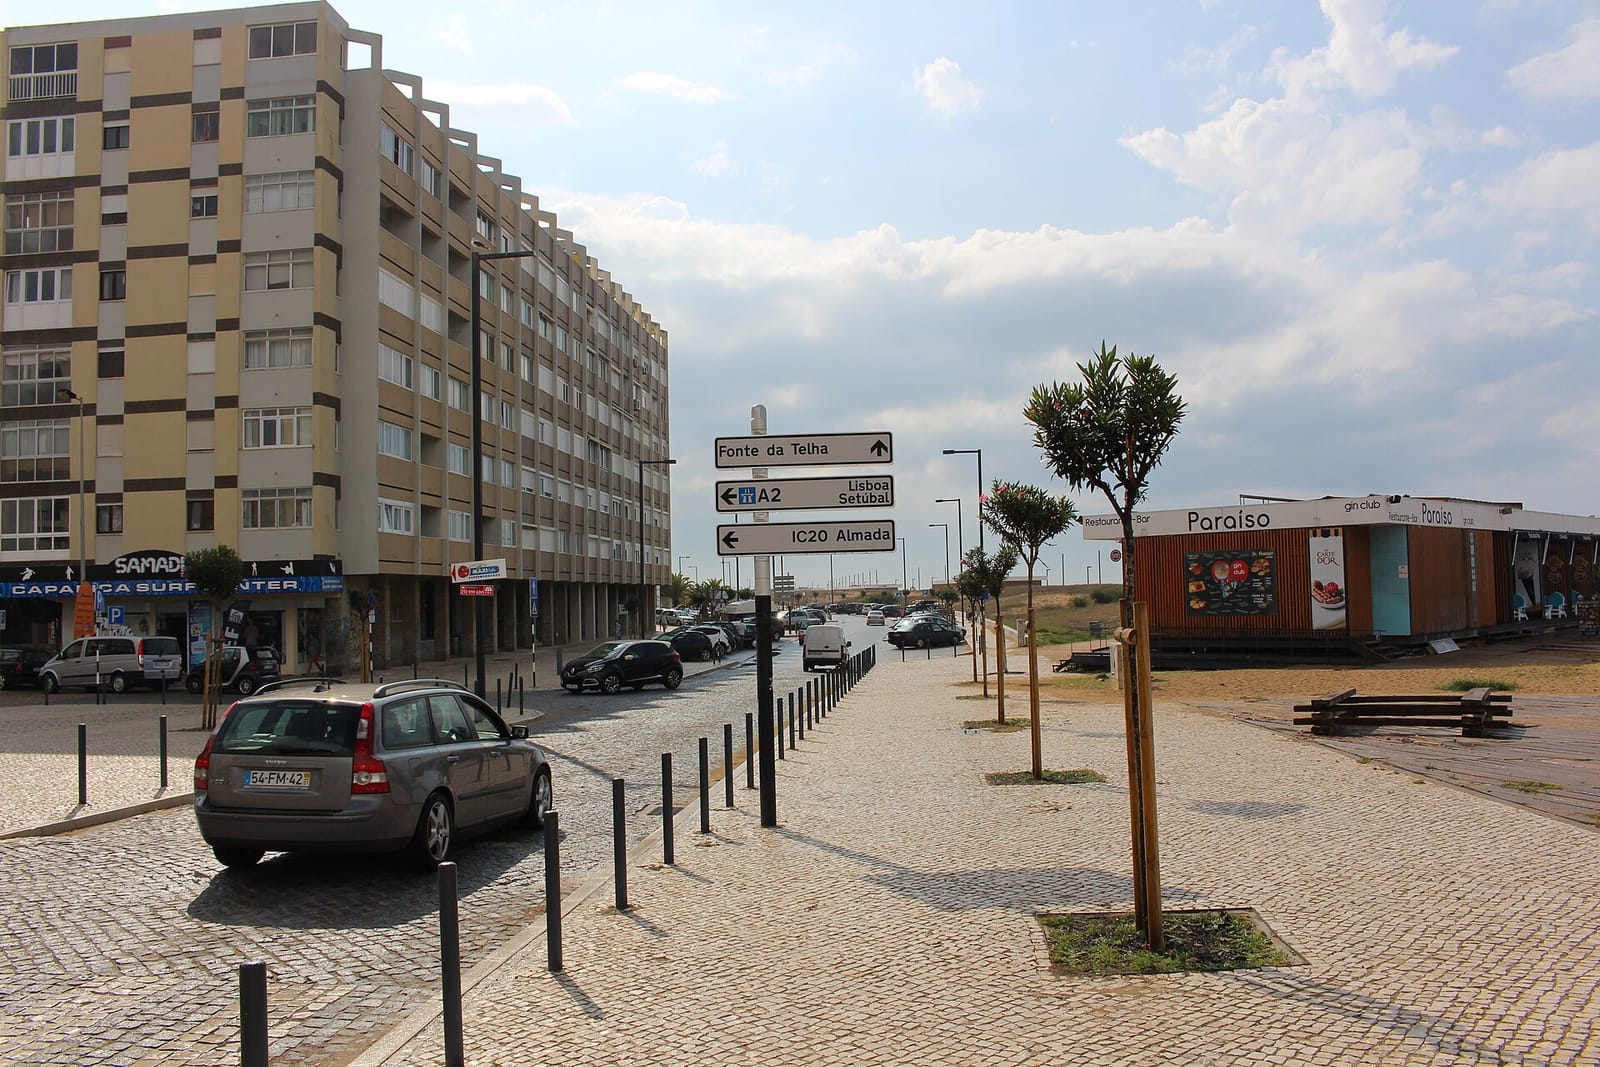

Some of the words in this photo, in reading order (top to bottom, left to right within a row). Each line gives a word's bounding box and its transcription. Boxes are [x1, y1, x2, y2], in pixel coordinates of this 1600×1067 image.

[719, 445, 759, 458] Fonte
[767, 444, 784, 456] da
[791, 443, 828, 455] Telha
[848, 480, 889, 492] Lisboa
[758, 488, 781, 502] A2
[839, 492, 890, 504] Setúbal
[1344, 501, 1358, 512] gin
[1360, 500, 1380, 510] club
[1188, 509, 1270, 531] Paraíso
[792, 530, 828, 543] IC20
[836, 528, 890, 542] Almada
[12, 583, 131, 595] CAPAICA
[136, 582, 197, 592] SURF
[111, 608, 121, 623] P
[251, 772, 303, 785] 54-FM-42
